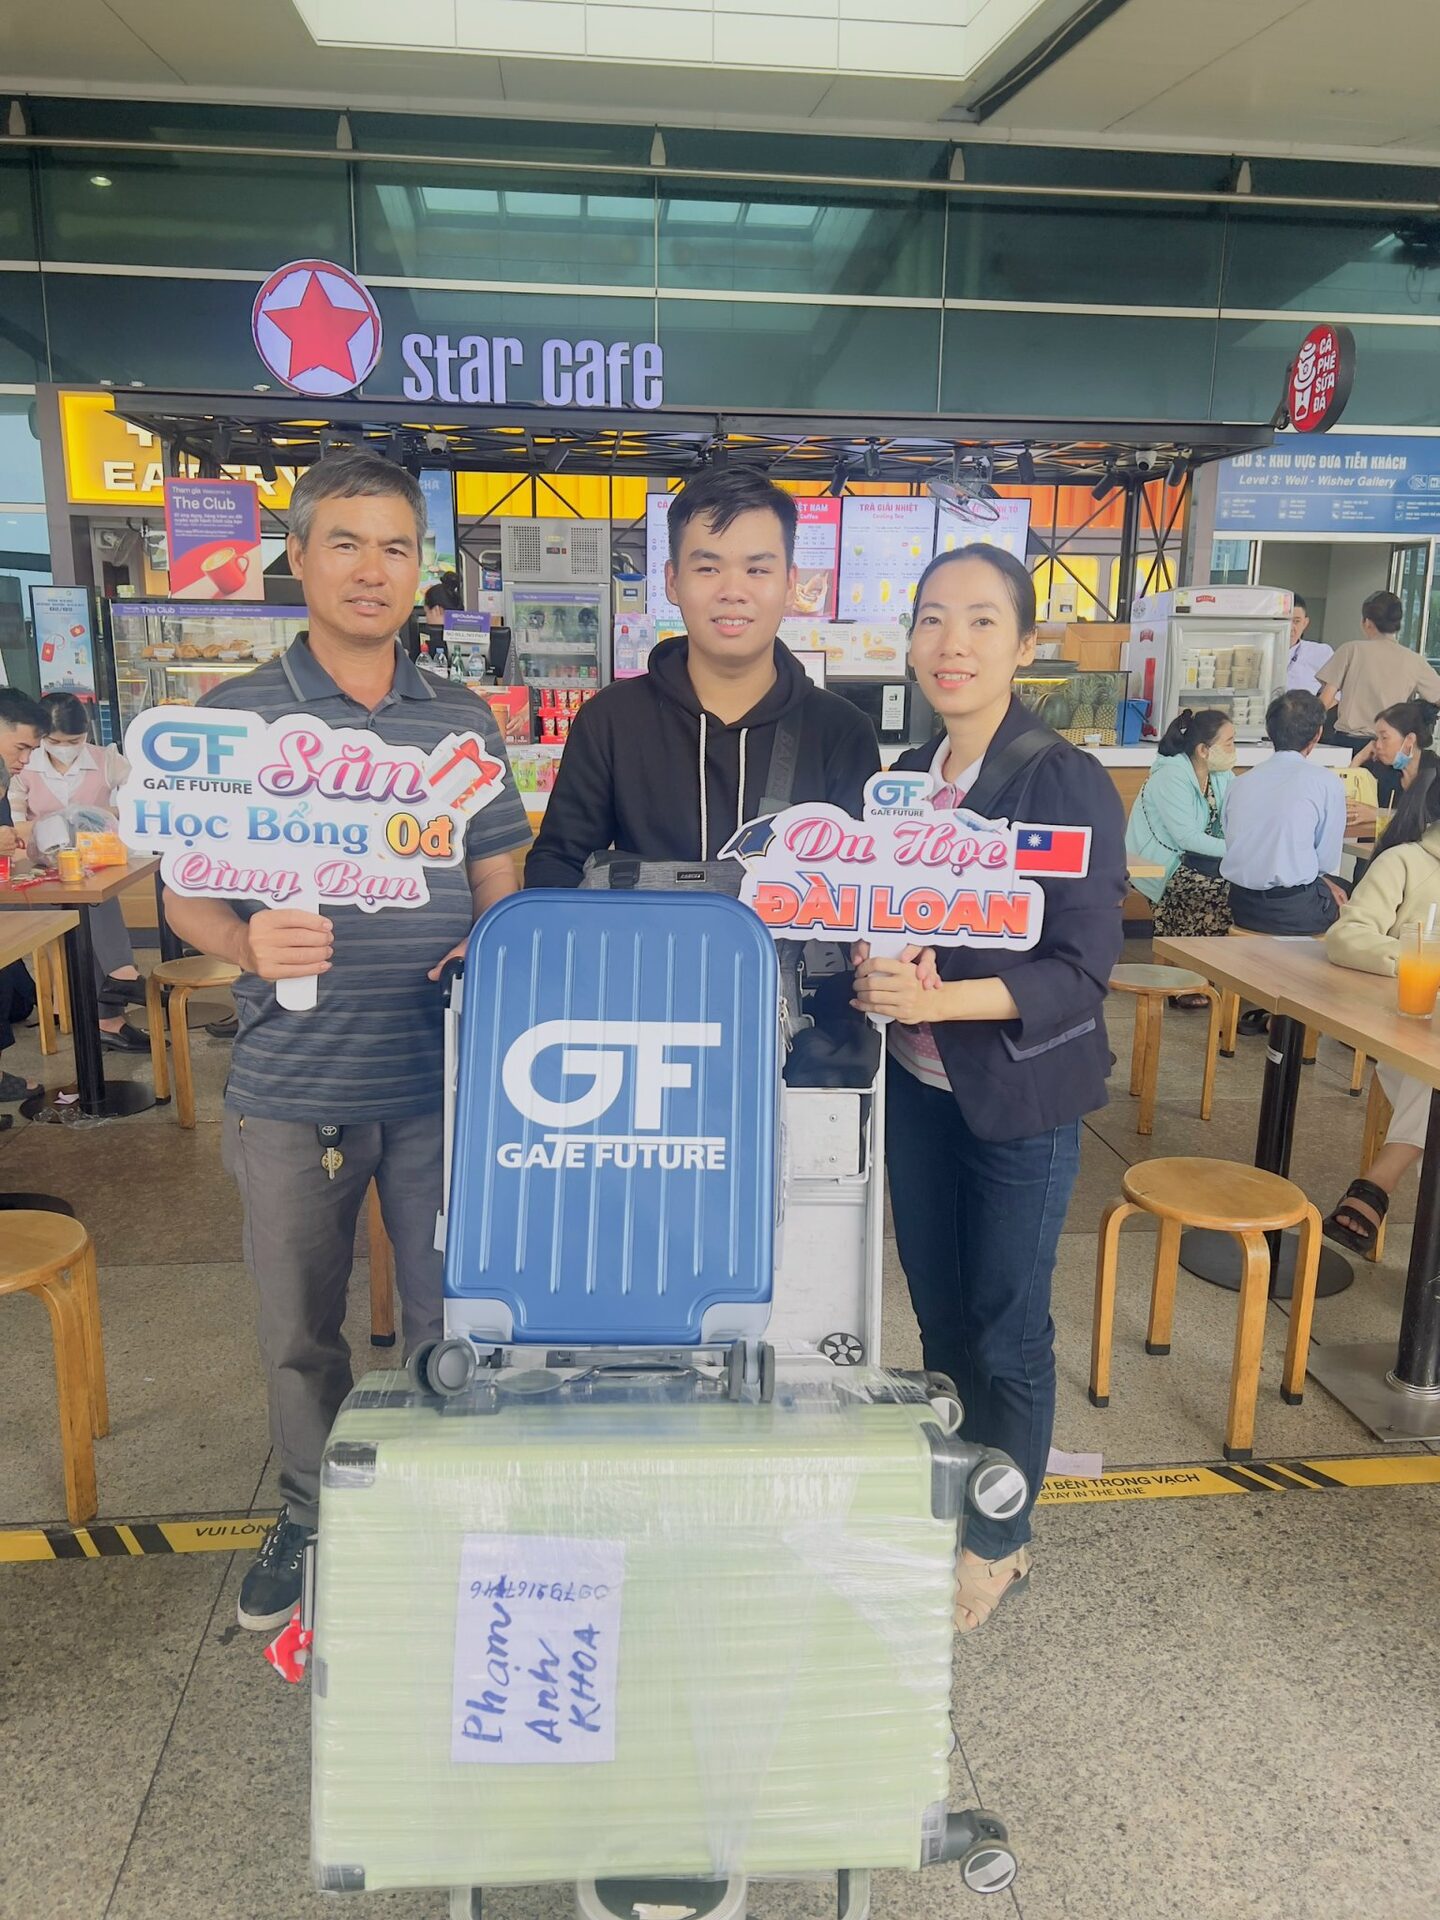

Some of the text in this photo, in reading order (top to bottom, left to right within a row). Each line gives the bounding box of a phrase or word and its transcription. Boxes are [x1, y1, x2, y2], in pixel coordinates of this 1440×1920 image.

[1269, 455, 1290, 468] KHU
[1239, 475, 1269, 485] Level
[1271, 475, 1281, 485] 3:
[1285, 475, 1308, 485] Well
[1317, 475, 1355, 486] Wisher
[1357, 476, 1397, 489] Gallery
[173, 496, 236, 510] The Club
[141, 606, 156, 614] The
[157, 606, 175, 614] Club
[142, 721, 248, 774] GF
[258, 730, 429, 804] Săn
[143, 775, 253, 795] GATE FUTURE
[873, 779, 925, 806] GF
[135, 799, 454, 858] Học Bổng 0đ
[892, 809, 925, 817] FUTURE
[784, 817, 1008, 876] Du Học
[172, 852, 421, 905] Cùng Bạn
[752, 871, 1031, 938] ĐÀI LOAN
[502, 1019, 722, 1129] GF
[496, 1134, 726, 1170] GATE FUTURE
[1041, 1491, 1070, 1500] STAY
[1089, 1488, 1115, 1497] THE
[1117, 1487, 1147, 1496] LINE
[1054, 1479, 1087, 1490] BÊN
[1089, 1475, 1151, 1488] TRONG
[1152, 1473, 1200, 1486] VẠCH
[196, 1522, 270, 1537] VUI LÒN
[524, 1637, 562, 1744] Anh
[568, 1623, 601, 1733] KHOA
